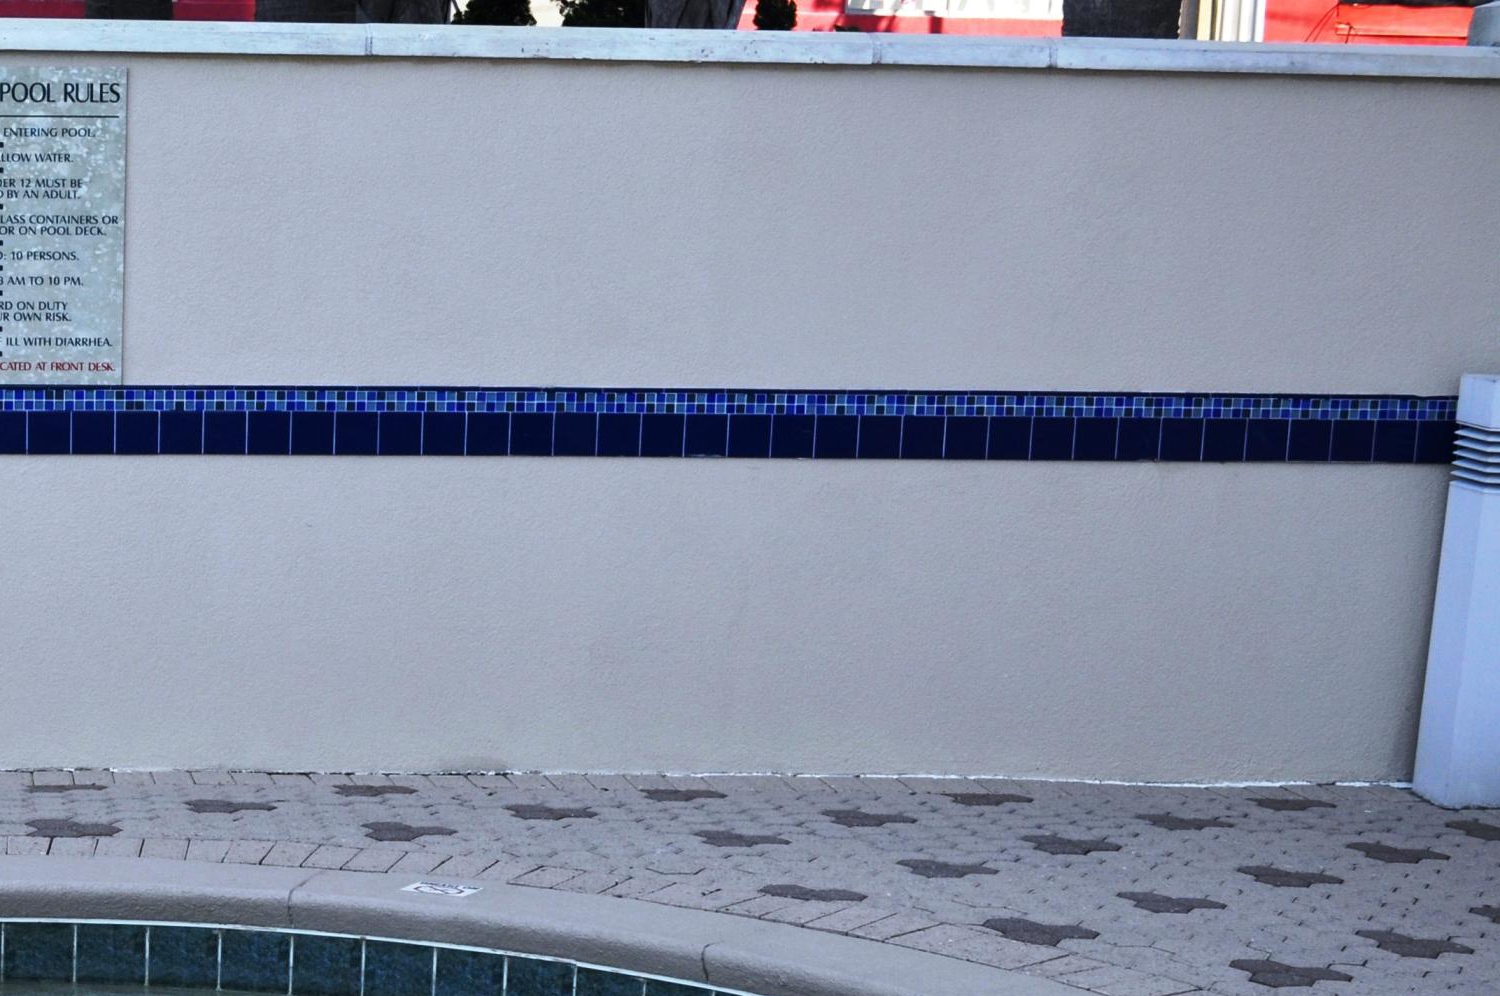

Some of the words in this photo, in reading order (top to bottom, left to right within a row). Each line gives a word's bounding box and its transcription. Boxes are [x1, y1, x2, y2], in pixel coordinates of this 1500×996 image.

[0, 83, 54, 102] POOL
[64, 83, 121, 103] RULES
[4, 128, 57, 137] ENTERING
[62, 128, 96, 137] POOL.
[35, 153, 74, 163] WATER.
[21, 179, 31, 188] 12
[35, 179, 67, 188] MUST
[70, 179, 83, 188] BE
[7, 190, 19, 199] BY
[23, 190, 38, 199] AN
[44, 190, 81, 199] ADULT.
[29, 215, 99, 225] CONTAINERS
[102, 215, 118, 225] OR
[0, 226, 15, 235] OR
[19, 226, 37, 235] ON
[40, 226, 71, 236] POOL
[75, 226, 107, 236] DECK.
[11, 251, 23, 260] 10
[27, 251, 79, 260] PERSONS.
[8, 276, 26, 285] AM
[29, 276, 44, 285] TO
[48, 277, 60, 285] 10
[64, 277, 83, 286] PM.
[17, 301, 35, 310] ON
[38, 302, 68, 311] DUTY
[13, 312, 42, 321] OWN
[46, 313, 72, 322] RISK.
[6, 337, 20, 346] ILL
[23, 337, 51, 346] WITH
[56, 337, 112, 347] DIARRHEA.
[35, 362, 47, 371] AT
[51, 362, 84, 371] FRONT
[89, 362, 116, 371] DESK.
